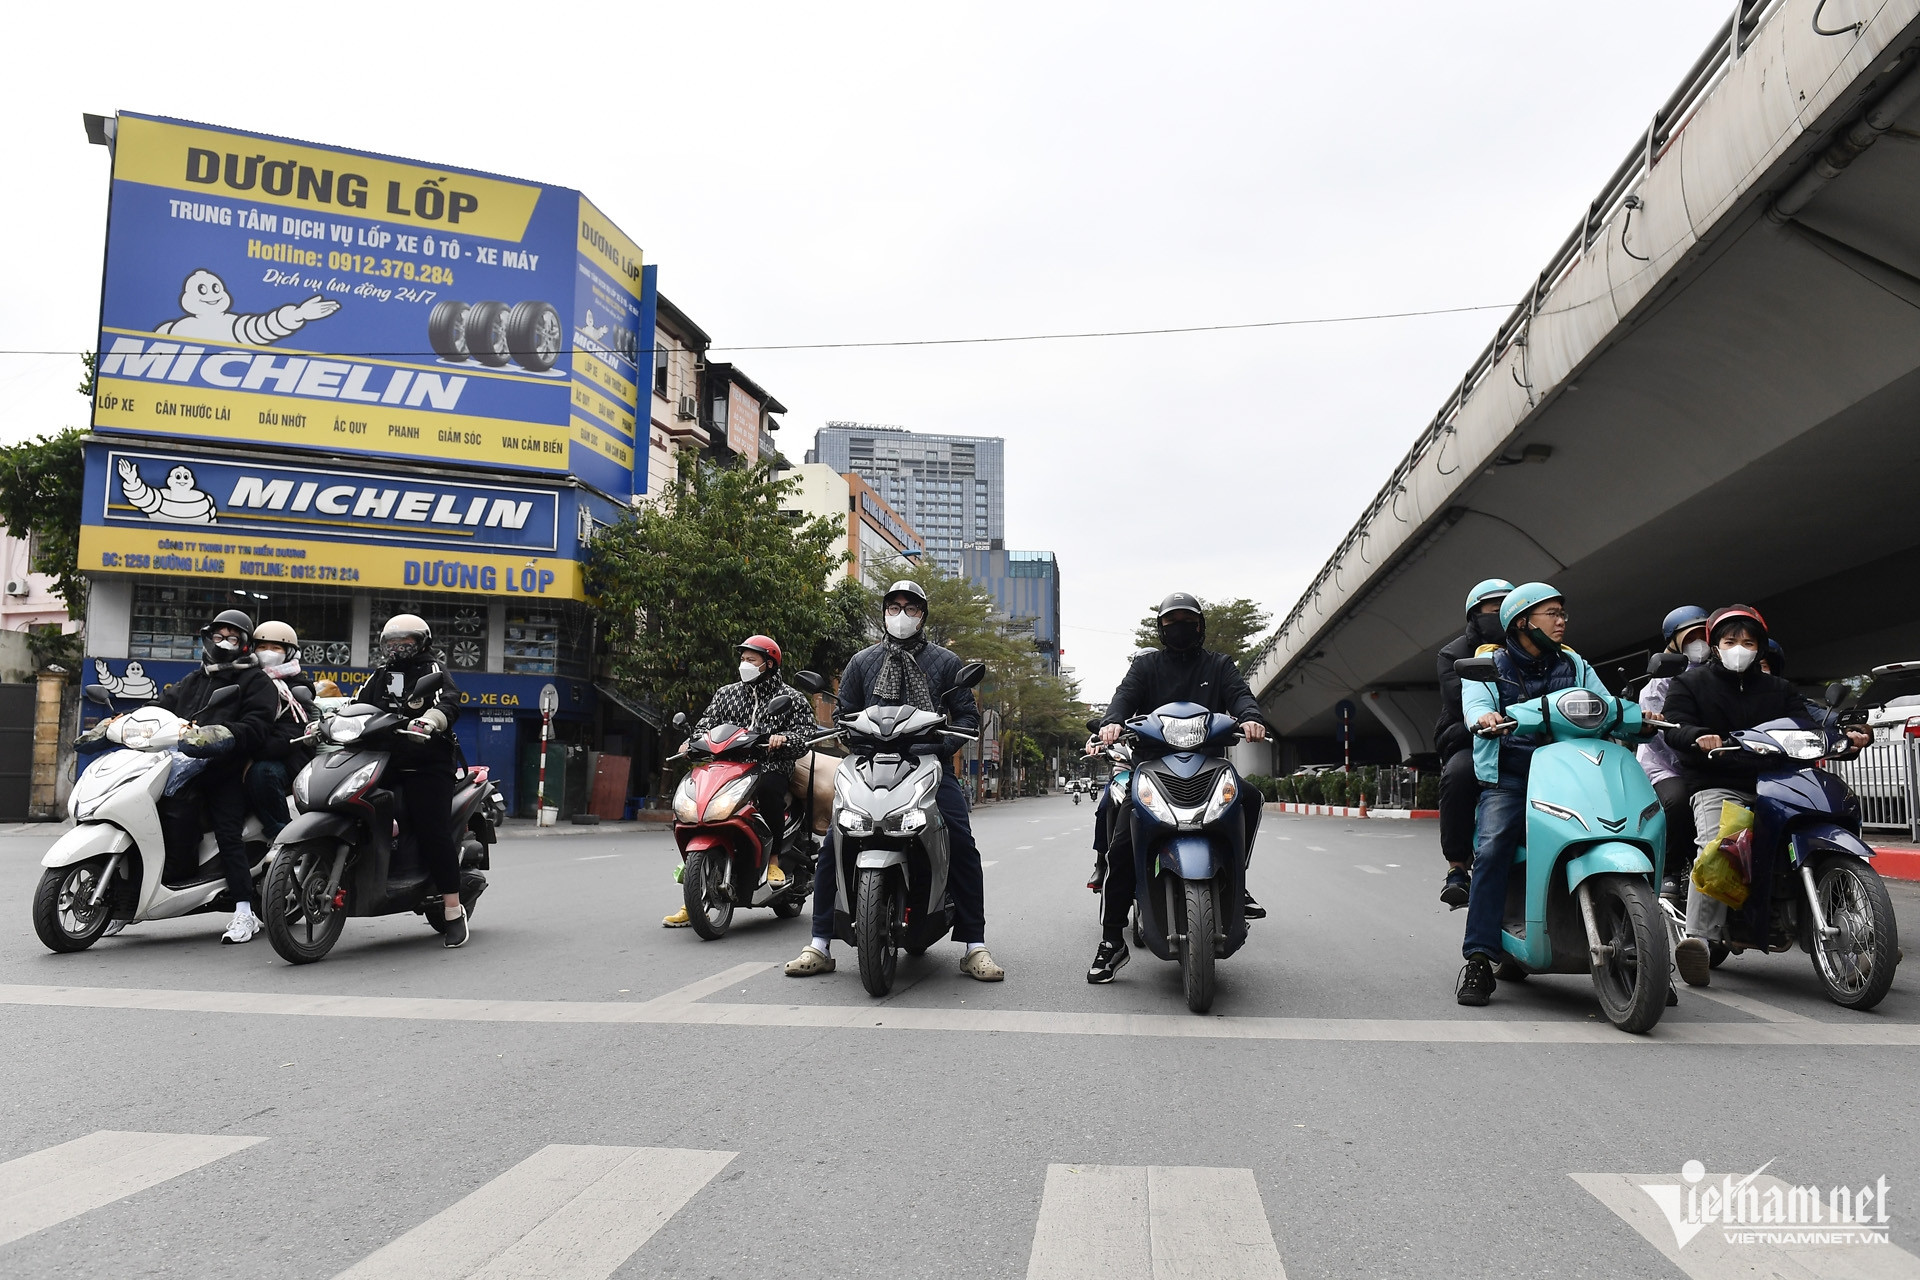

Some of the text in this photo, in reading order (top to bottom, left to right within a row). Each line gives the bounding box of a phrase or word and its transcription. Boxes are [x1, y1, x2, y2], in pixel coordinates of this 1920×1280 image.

[186, 147, 478, 224] DƯƠNG LỐP
[169, 199, 232, 226] TRUNG
[237, 208, 277, 233] TÂM
[282, 217, 325, 240] DỊCH
[330, 224, 353, 247] VỤ
[357, 225, 391, 249] LỐP
[395, 234, 418, 254] XE
[423, 235, 435, 256] Ô
[439, 239, 461, 260] TÔ
[476, 246, 498, 265] XE
[502, 250, 539, 271] MÁY
[582, 221, 640, 282] DƯƠNG LỐP
[247, 239, 454, 286] Hotline: 0912.379.284
[262, 268, 437, 305] Dịch vụ lưu động 24/7
[99, 337, 468, 410] MICHELIN
[573, 331, 619, 370] MICHELIN
[98, 392, 118, 410] LỐP
[121, 398, 135, 412] XE
[155, 399, 176, 416] CÂN
[180, 403, 212, 419] THƯỚC
[281, 413, 307, 428] NHỚT
[349, 421, 368, 435] QUY
[388, 424, 420, 439] PHANH
[438, 427, 461, 443] GIẢM
[464, 430, 482, 445] SÓC
[502, 436, 519, 450] VAN
[521, 435, 541, 452] CẢM
[543, 438, 563, 454] BIẾN
[227, 476, 534, 530] MICHELIN
[102, 552, 122, 567] ĐC:
[153, 552, 193, 571] ĐƯỜNG
[195, 555, 225, 573] LÁNG
[240, 561, 289, 577] HOTLINE:
[290, 564, 316, 579] 0912
[318, 565, 338, 580] 379
[339, 567, 360, 582] 284
[158, 538, 184, 551] CÔNG
[185, 541, 197, 551] TY
[198, 542, 223, 553] TNHH
[404, 558, 555, 593] DƯƠNG LỐP
[480, 693, 497, 705] XE
[500, 693, 520, 706] GA
